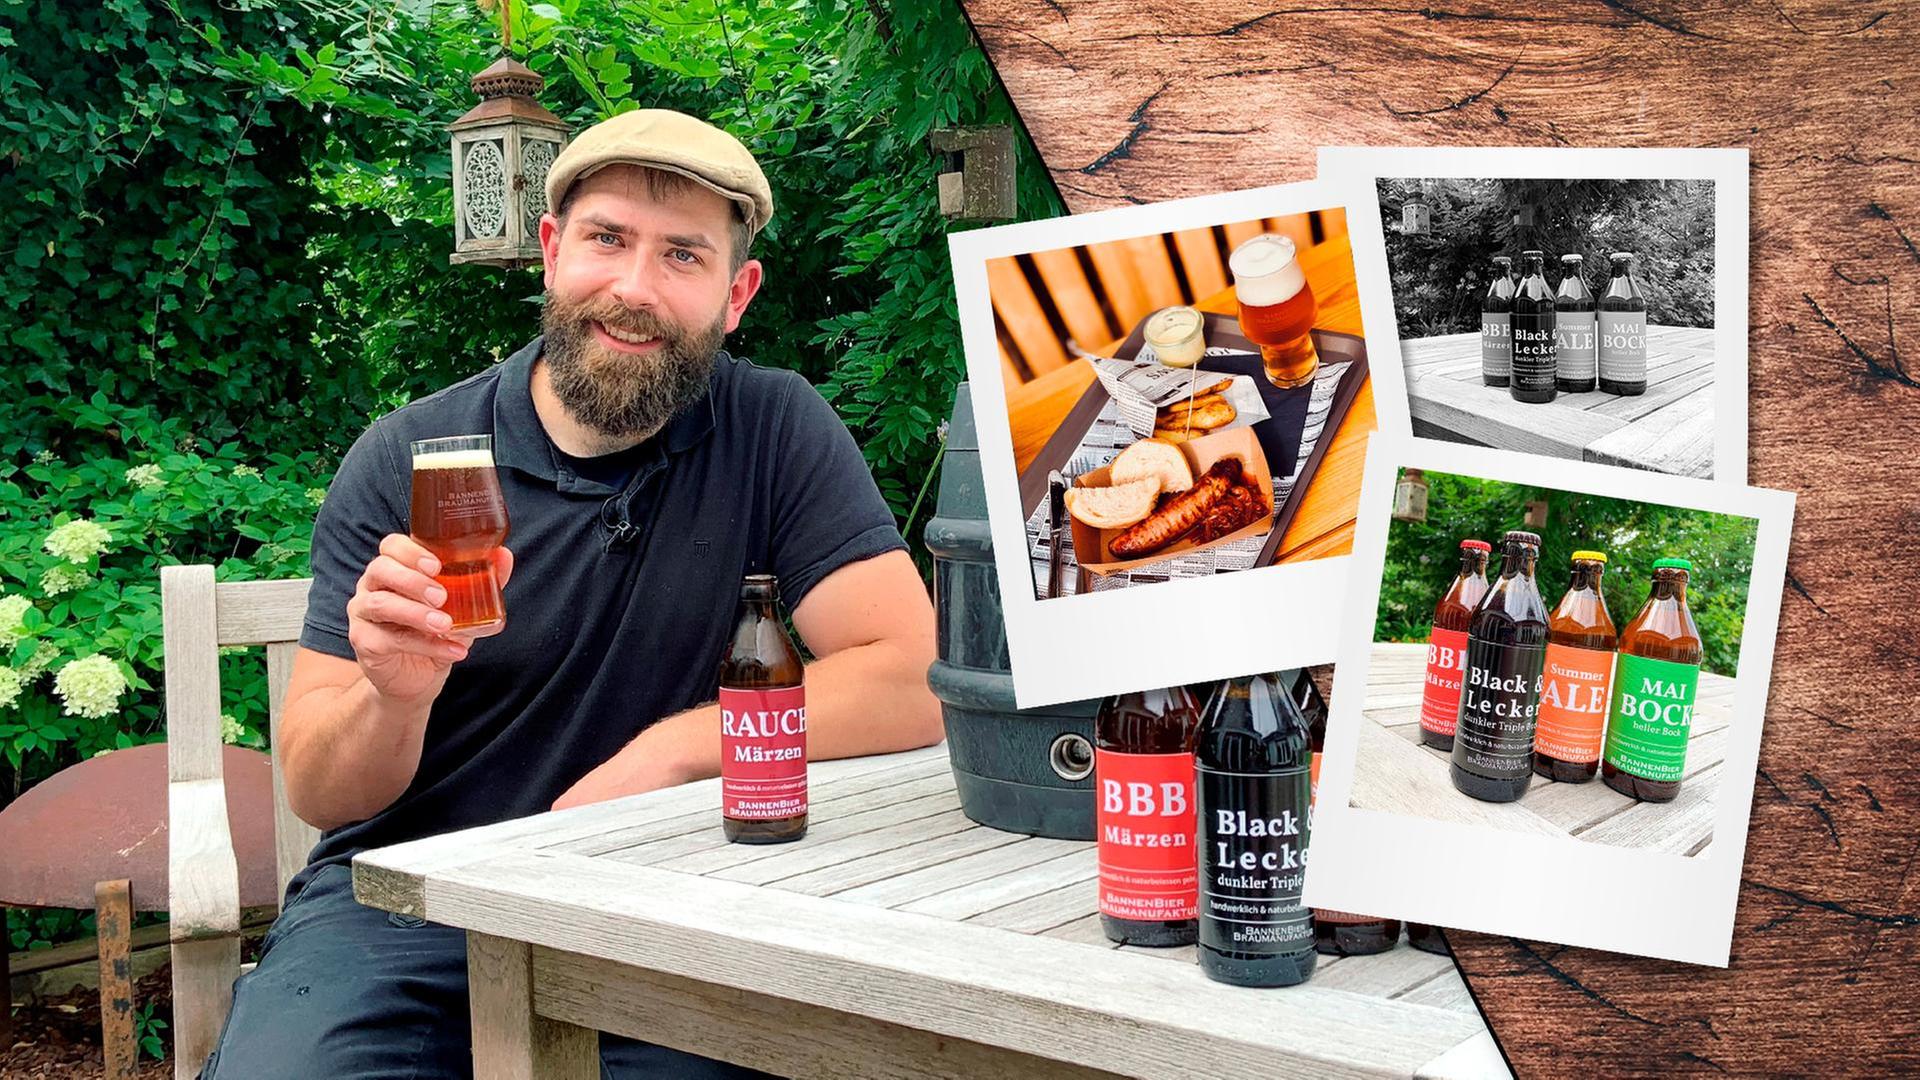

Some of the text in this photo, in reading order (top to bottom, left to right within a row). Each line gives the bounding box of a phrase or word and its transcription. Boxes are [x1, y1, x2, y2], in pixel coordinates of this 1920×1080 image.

[1515, 328, 1549, 341] Black
[1613, 323, 1639, 334] MAI
[1557, 333, 1594, 350] ALE
[1602, 334, 1646, 350] BOCK
[1469, 666, 1544, 694] Black &
[1550, 663, 1605, 682] Summer
[1540, 679, 1606, 714] ALE
[1640, 676, 1688, 701] MAI
[1620, 692, 1693, 727] BOCK
[722, 707, 807, 737] RAUCH
[1463, 711, 1497, 730] dunkler
[1498, 721, 1526, 735] Triple
[1632, 720, 1682, 738] heller Bock
[735, 746, 802, 762] Märzen
[738, 798, 801, 811] BANNENBIER
[1103, 778, 1187, 817] BBB
[1216, 809, 1300, 838] Black
[1104, 824, 1187, 847] Märzen
[1216, 841, 1310, 871] Lecke
[1217, 872, 1269, 890] dunkler
[1106, 891, 1185, 909] BANNENBIER
[1210, 899, 1258, 914] handwerklich
[1259, 905, 1267, 915] &
[1245, 924, 1306, 937] BANNENBIER
